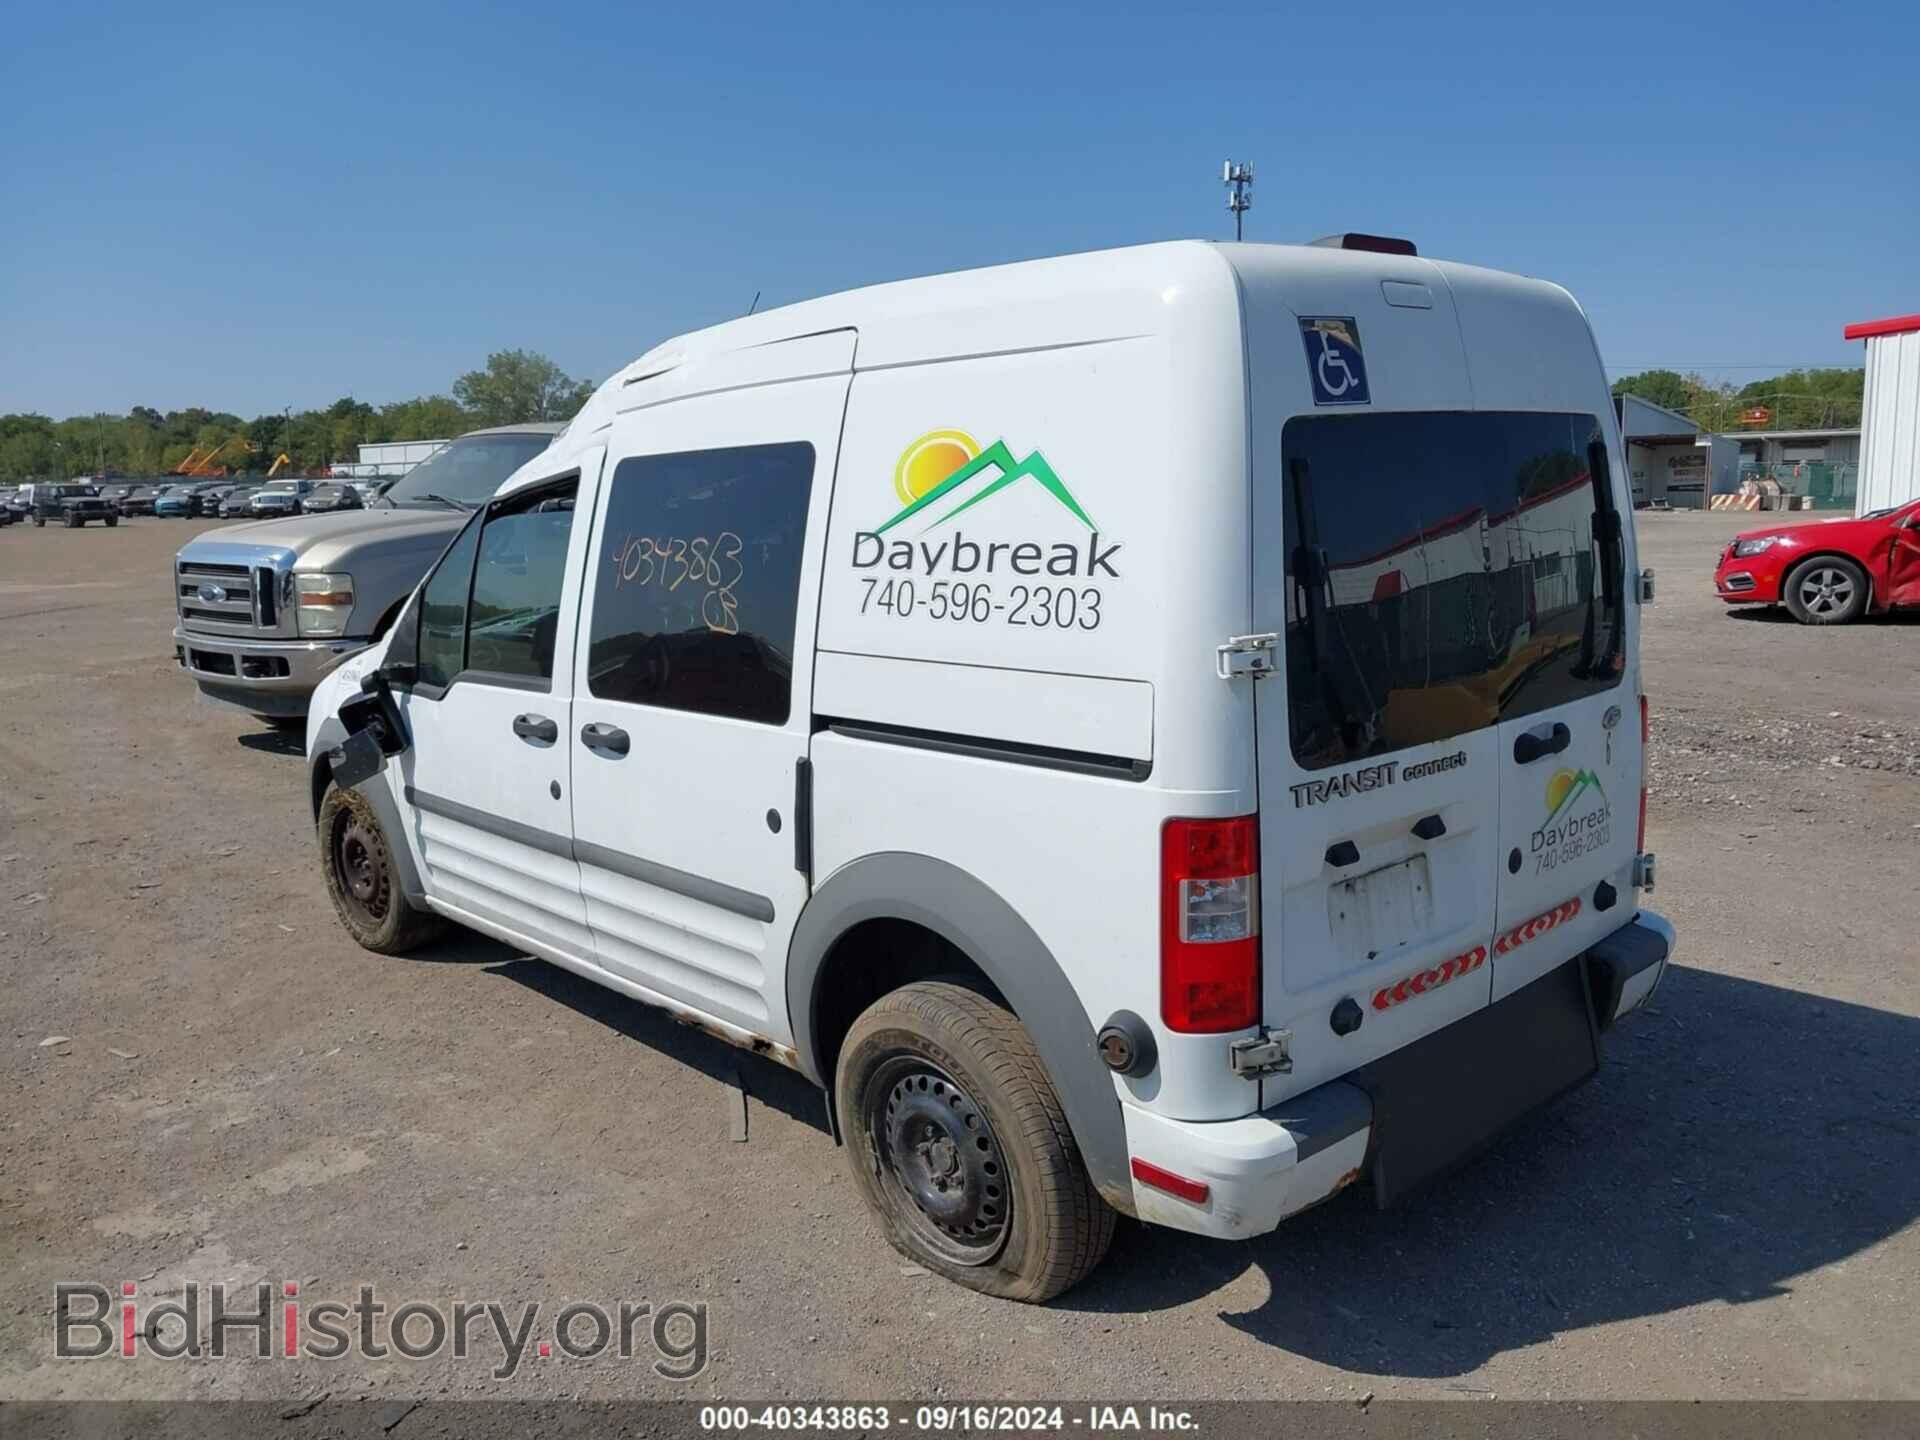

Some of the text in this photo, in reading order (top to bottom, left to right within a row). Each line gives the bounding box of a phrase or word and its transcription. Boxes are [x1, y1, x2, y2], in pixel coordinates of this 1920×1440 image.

[612, 532, 744, 591] 40343863
[851, 531, 1121, 578] Daybreak
[859, 579, 1102, 630] 740-596-2303
[1290, 750, 1467, 808] TRANSIT connect
[1531, 802, 1611, 852] Daybreak
